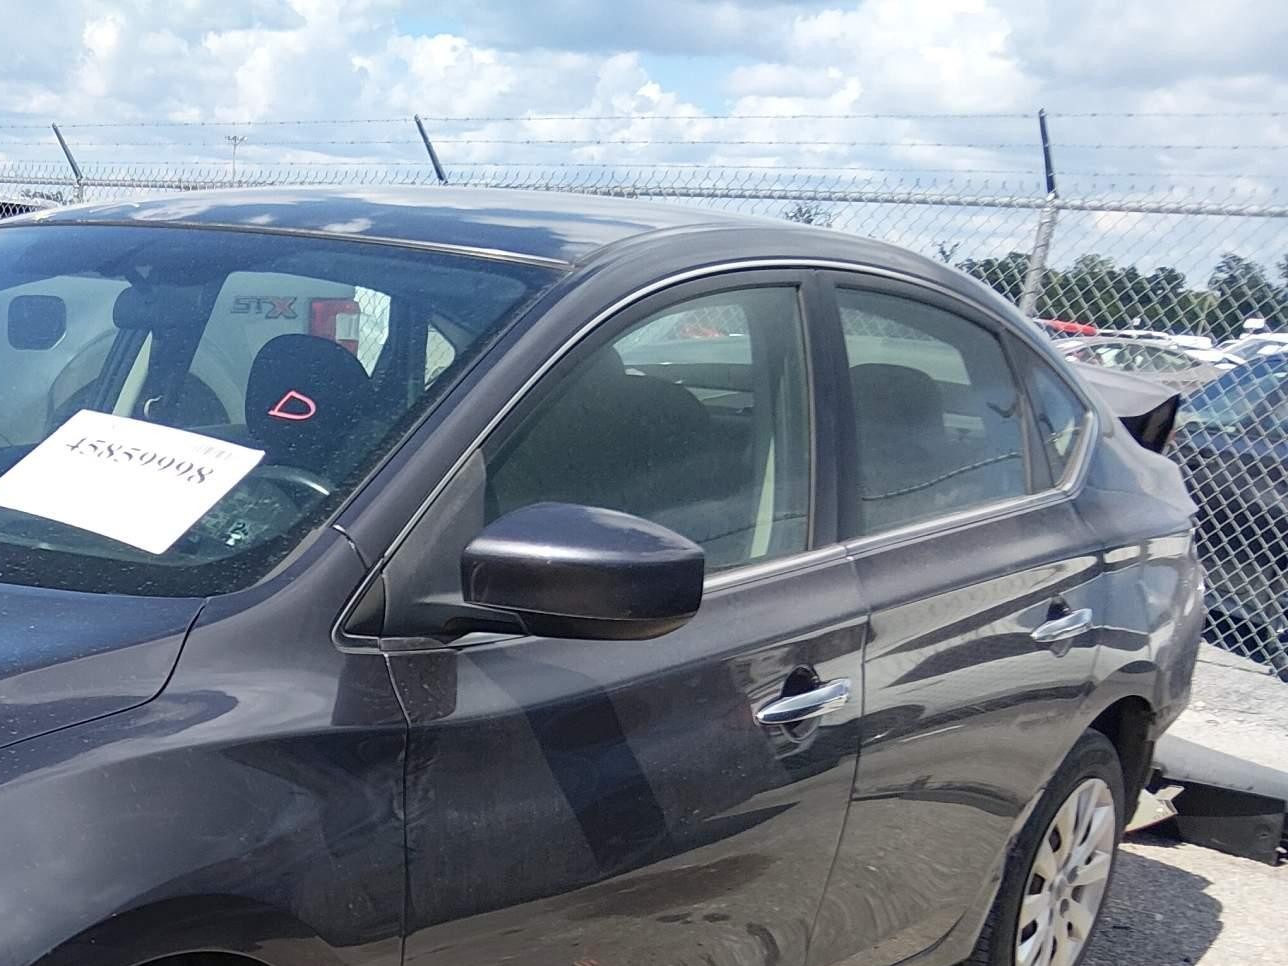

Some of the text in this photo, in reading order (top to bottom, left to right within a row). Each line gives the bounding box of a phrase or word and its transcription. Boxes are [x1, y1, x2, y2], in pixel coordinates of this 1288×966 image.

[230, 295, 298, 319] STX
[267, 390, 316, 420] D
[66, 437, 214, 484] 45859998
